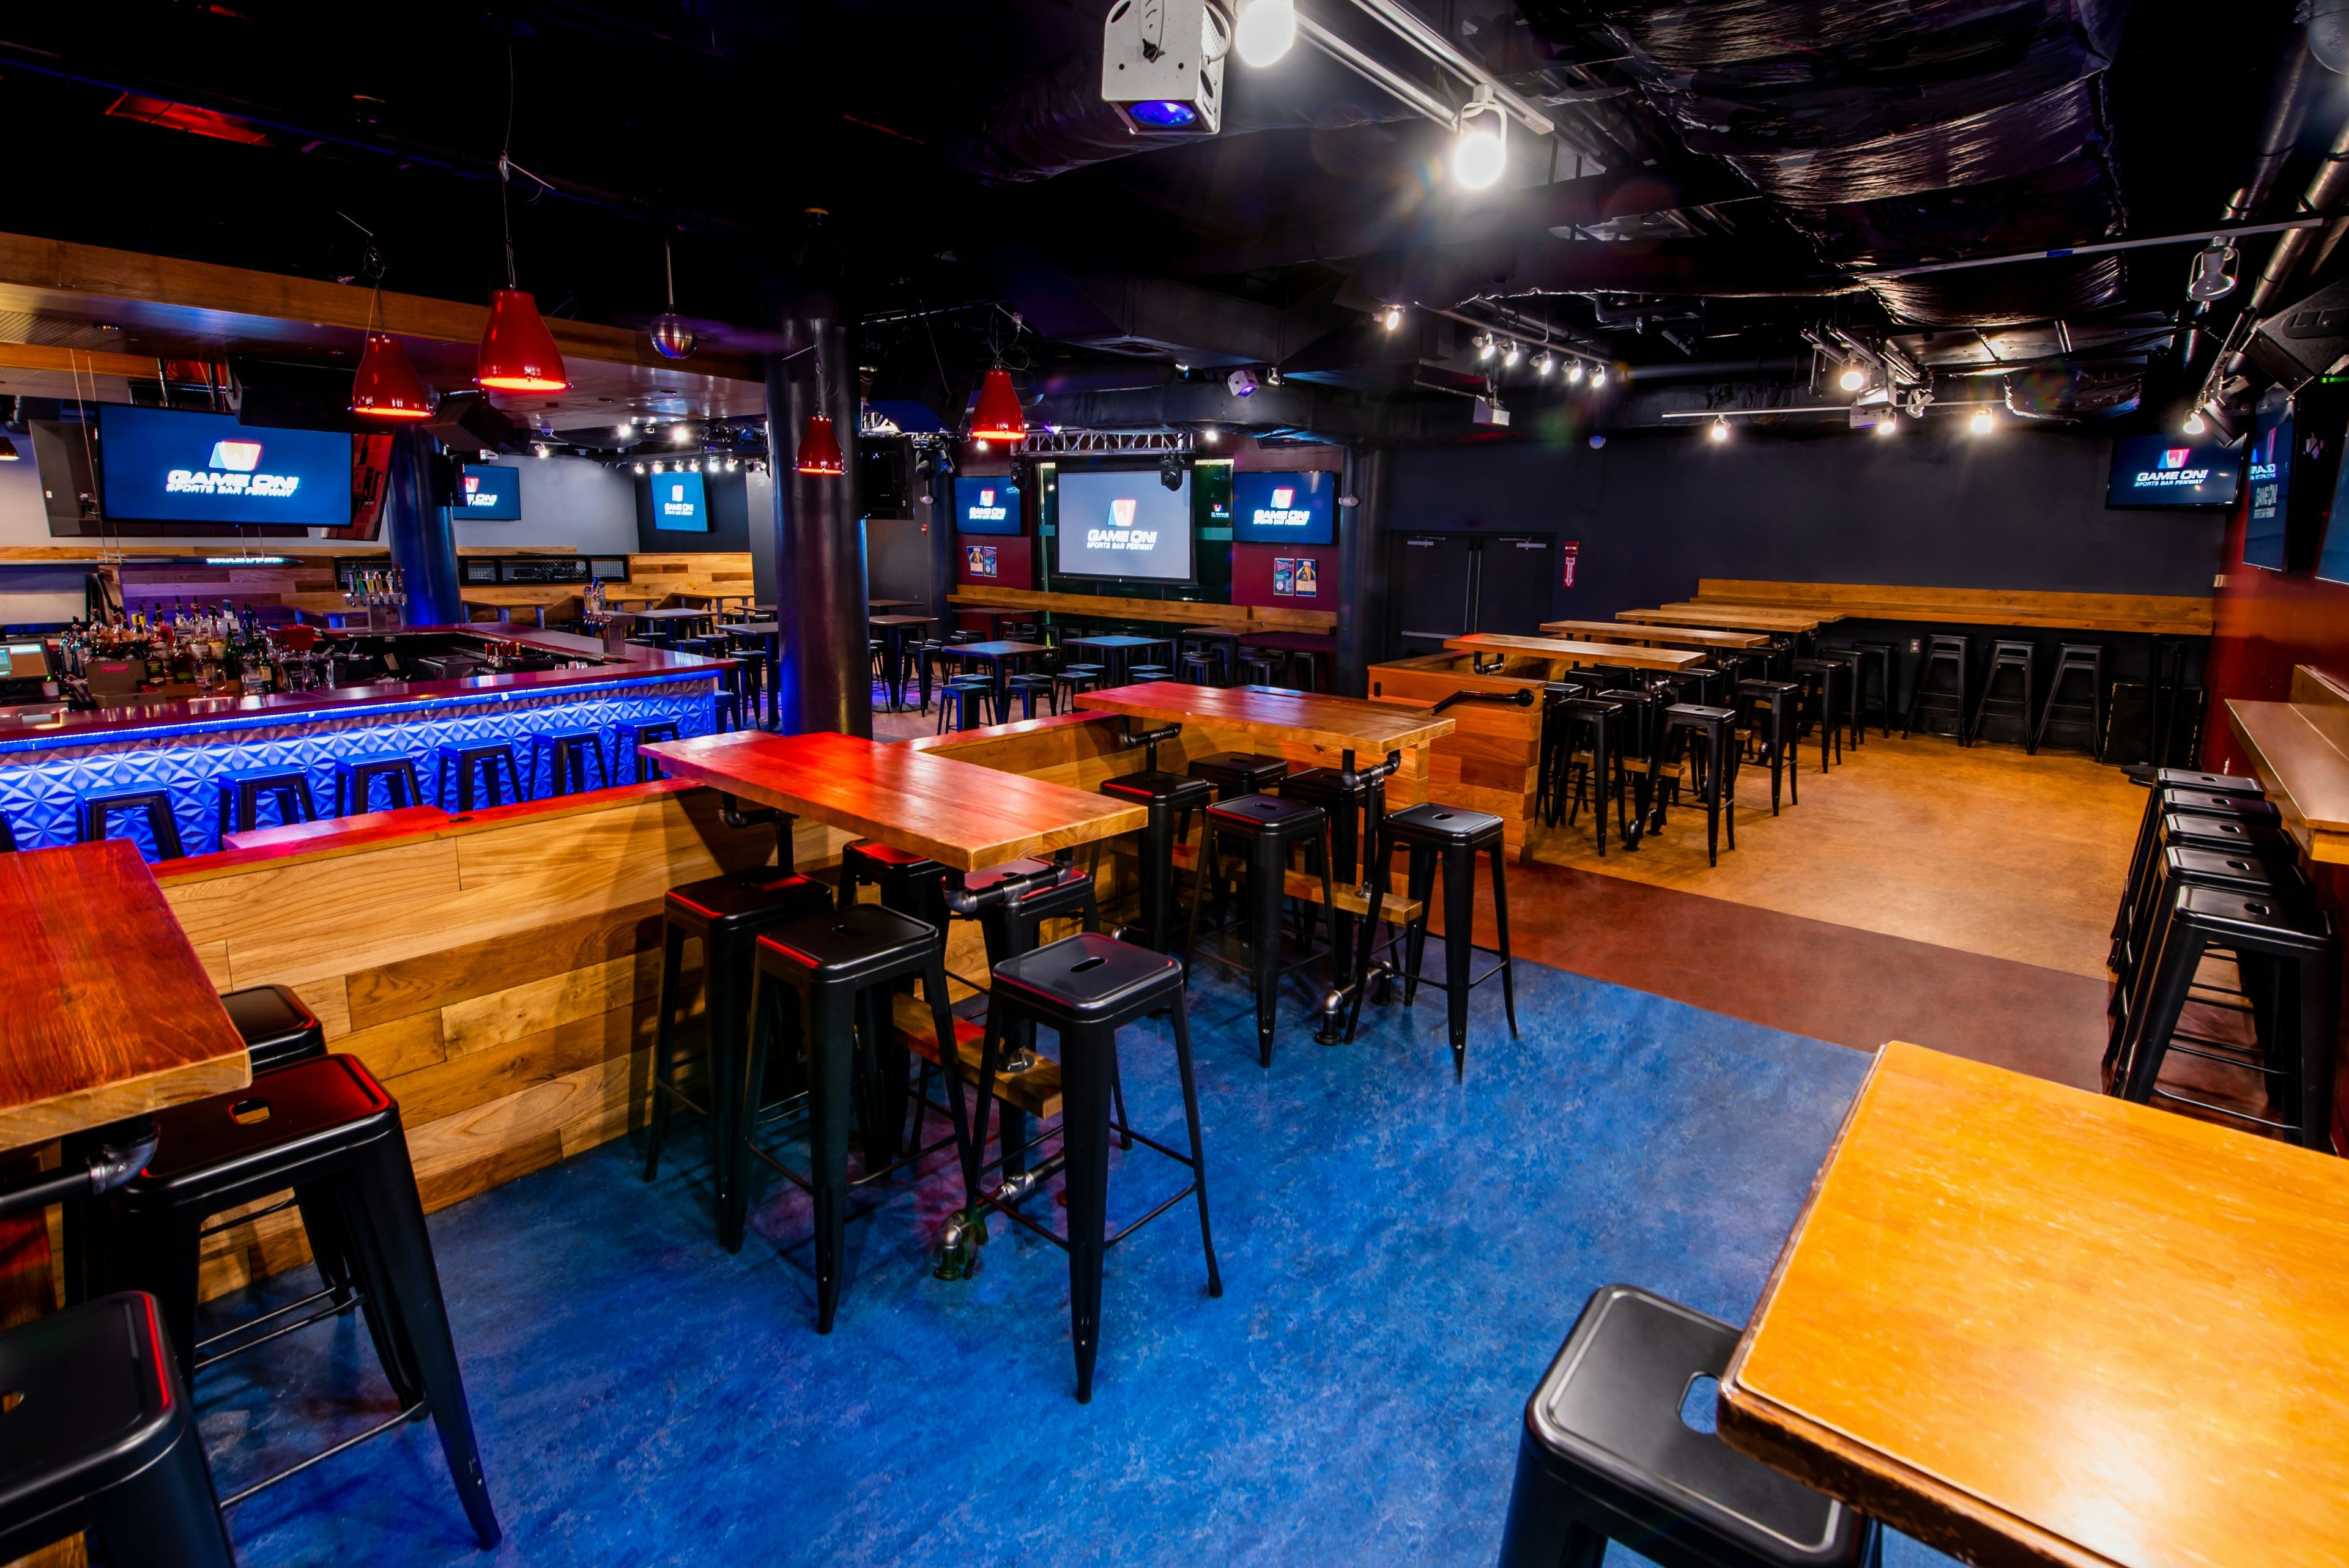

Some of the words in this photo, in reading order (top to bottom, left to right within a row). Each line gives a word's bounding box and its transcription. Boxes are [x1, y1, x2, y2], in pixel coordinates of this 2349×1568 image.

[168, 470, 250, 487] GAME
[252, 474, 299, 490] ON!
[2136, 471, 2180, 482] GAME
[2180, 470, 2209, 479] ON!
[166, 483, 215, 494] SPORTS
[217, 485, 242, 495] BAR
[1254, 509, 1288, 520] GAME
[1088, 529, 1130, 542] GAME
[1130, 530, 1157, 544] ON!
